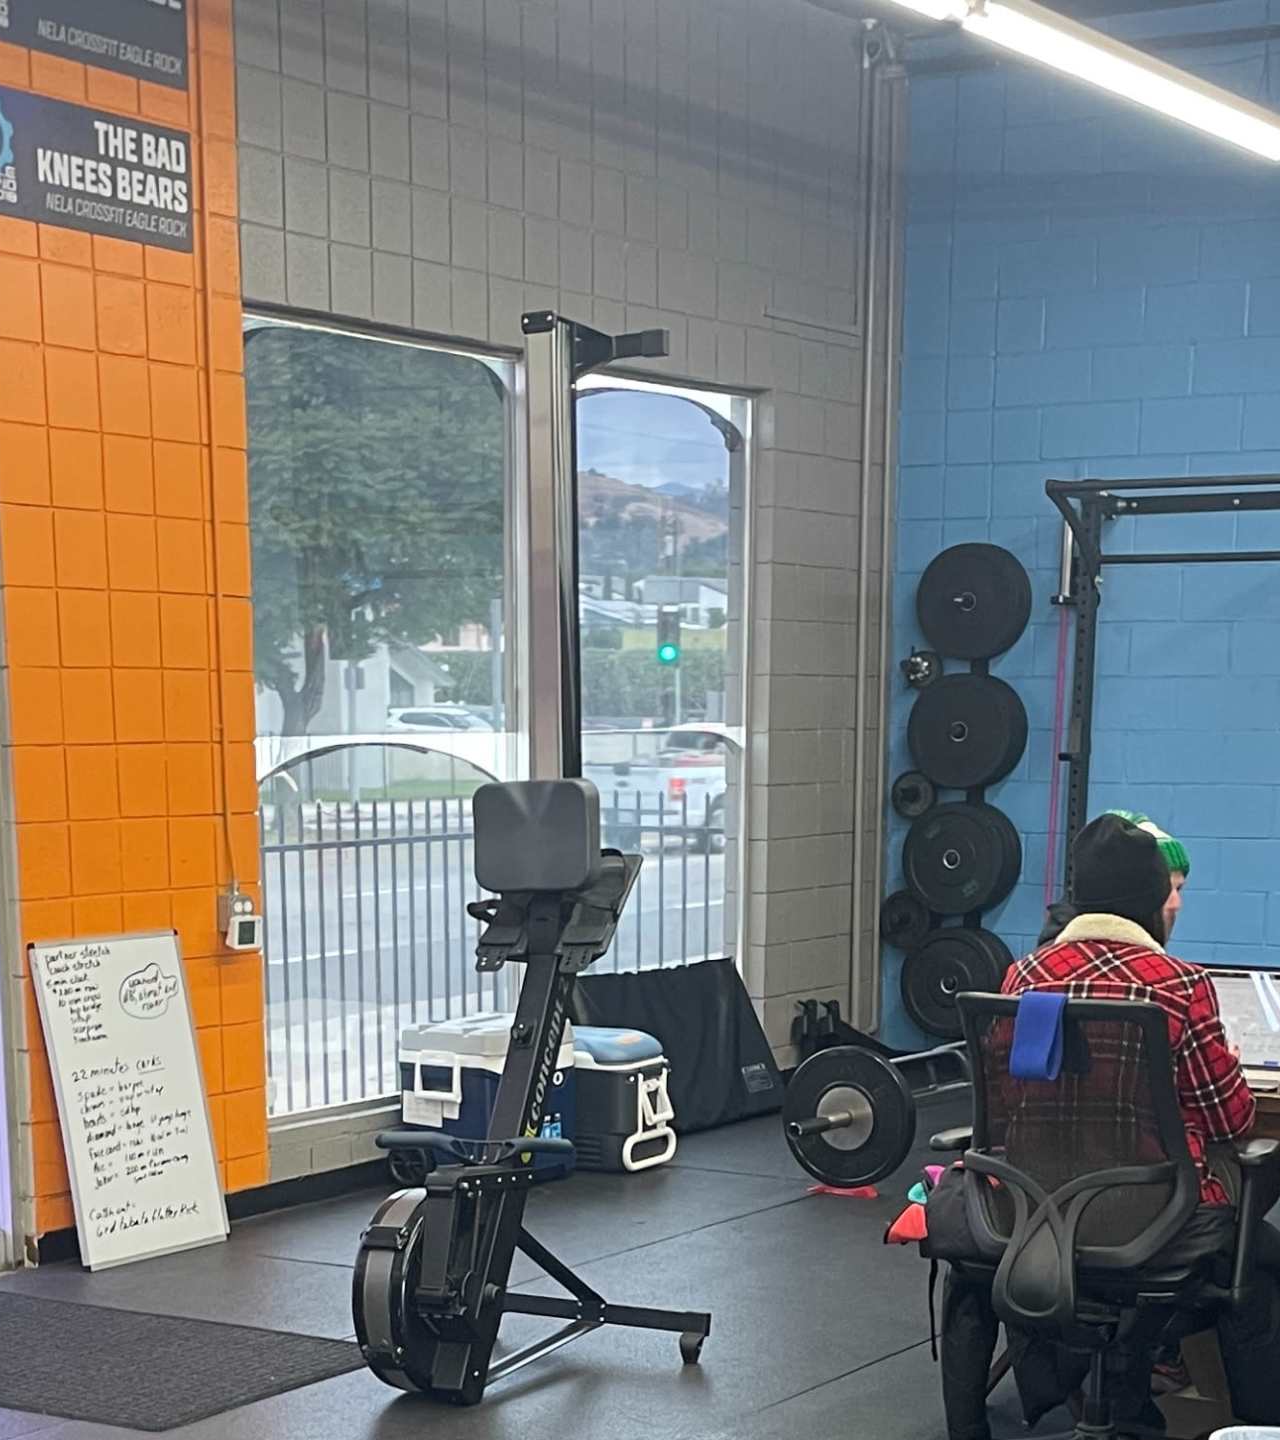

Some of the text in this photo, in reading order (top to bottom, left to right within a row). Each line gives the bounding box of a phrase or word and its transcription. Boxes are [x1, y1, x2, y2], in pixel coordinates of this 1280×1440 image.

[38, 18, 182, 75] NELA CROSSFIT EAGLE ROCK
[94, 120, 187, 174] THE BAD
[36, 148, 188, 214] KNEES BEARS
[46, 192, 187, 238] NELA CROSSFIT EAGLE ROCK
